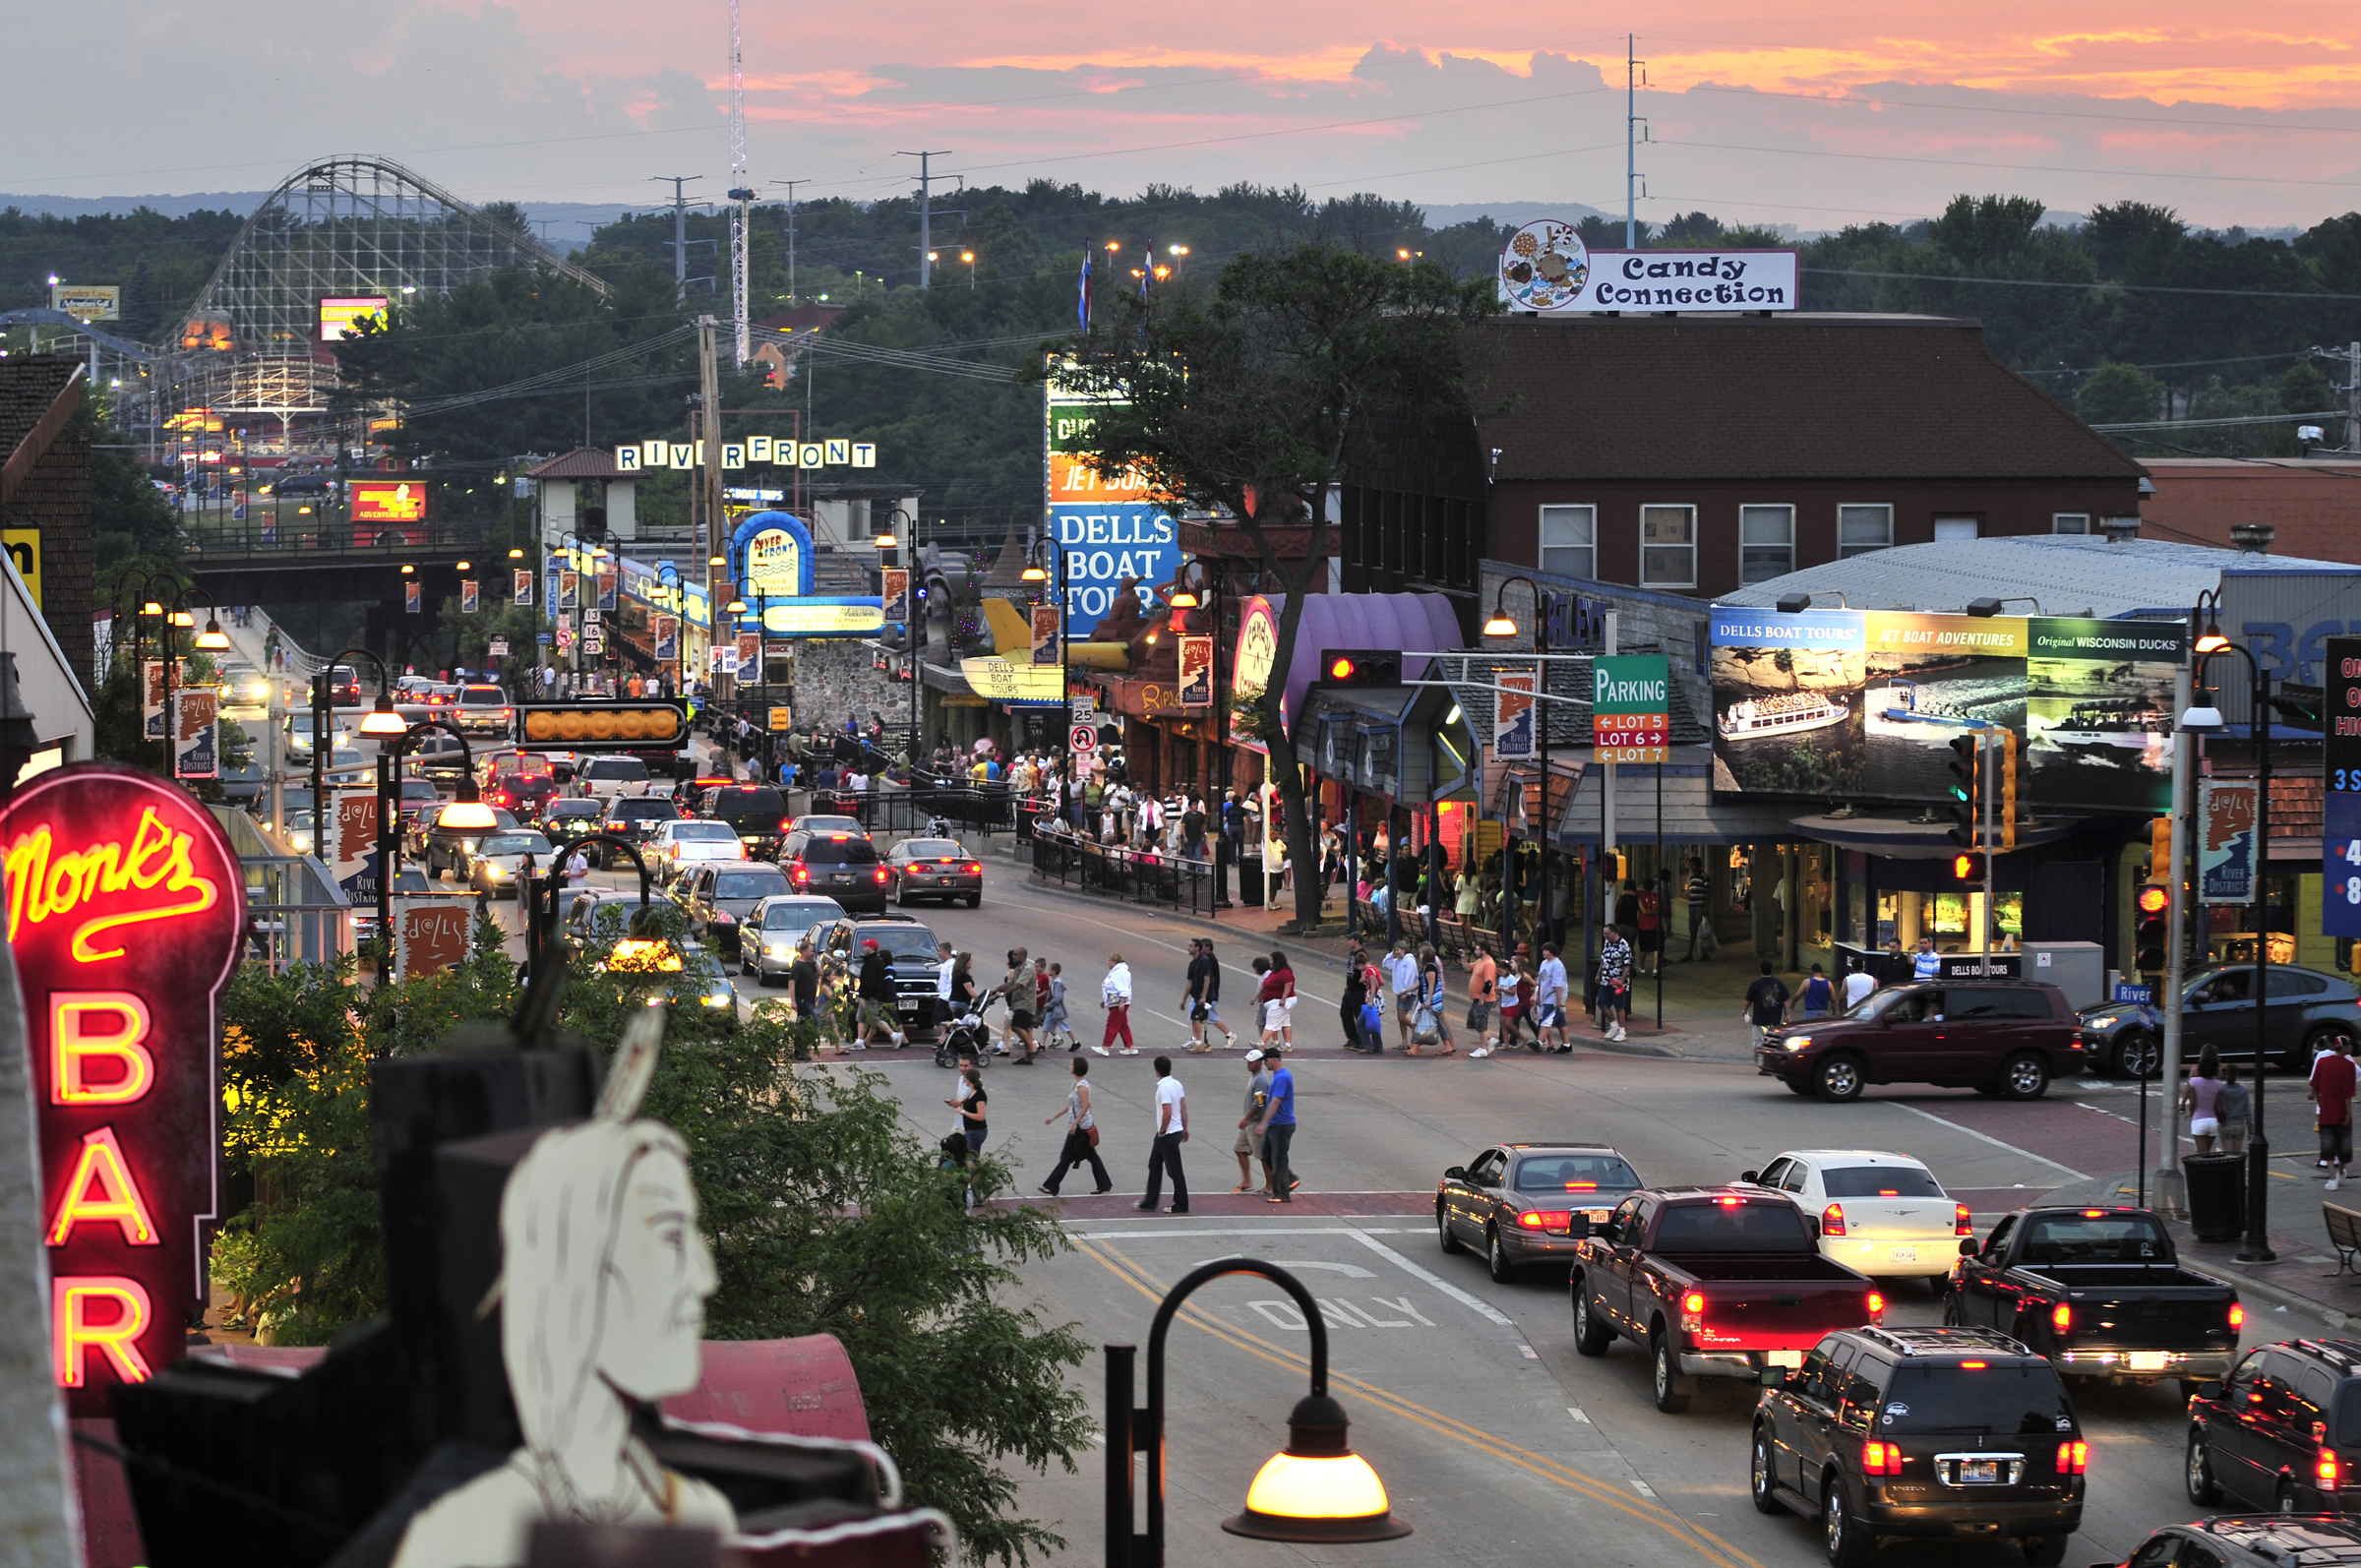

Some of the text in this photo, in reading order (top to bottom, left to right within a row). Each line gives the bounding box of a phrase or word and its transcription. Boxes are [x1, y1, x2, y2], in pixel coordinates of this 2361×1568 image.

[1623, 256, 1747, 280] Candy
[1596, 282, 1785, 305] Connection
[621, 438, 872, 468] RIVRFRONT
[1059, 514, 1174, 544] DELLS
[764, 543, 794, 558] FRONT
[1067, 550, 1161, 580] BOAT
[1060, 586, 1154, 616] TOUR
[1720, 625, 1762, 637] DELLS
[1765, 627, 1802, 638] BOAT
[1879, 630, 2015, 646] JET BOAT ADVENTURES
[2037, 635, 2075, 648] Original
[2077, 636, 2137, 649] WISCONSIN
[1184, 642, 1209, 659] dells
[988, 663, 1015, 673] DELLS
[991, 674, 1013, 683] BOAT
[1596, 668, 1665, 702] PARKING
[991, 685, 1018, 694] TOURS
[1192, 684, 1207, 693] RIVER
[181, 694, 212, 717] dells
[1074, 710, 1093, 721] 25
[1616, 715, 1663, 728] LOT 5
[1510, 731, 1528, 742] RIVER
[1600, 733, 1645, 745] LOT 6
[192, 750, 211, 760] RIVER
[1616, 748, 1663, 761] LOT 7
[2334, 769, 2346, 790] 3
[2210, 792, 2251, 818] dells
[341, 802, 375, 829] dell
[2221, 865, 2245, 879] RIVER
[356, 874, 376, 890] RIVE
[408, 914, 462, 948] dells
[1951, 965, 1970, 976] DELLS
[1989, 964, 2008, 975] OURS
[2120, 986, 2151, 1001] River
[45, 992, 159, 1388] BAR
[1246, 1297, 1437, 1331] ONLY
